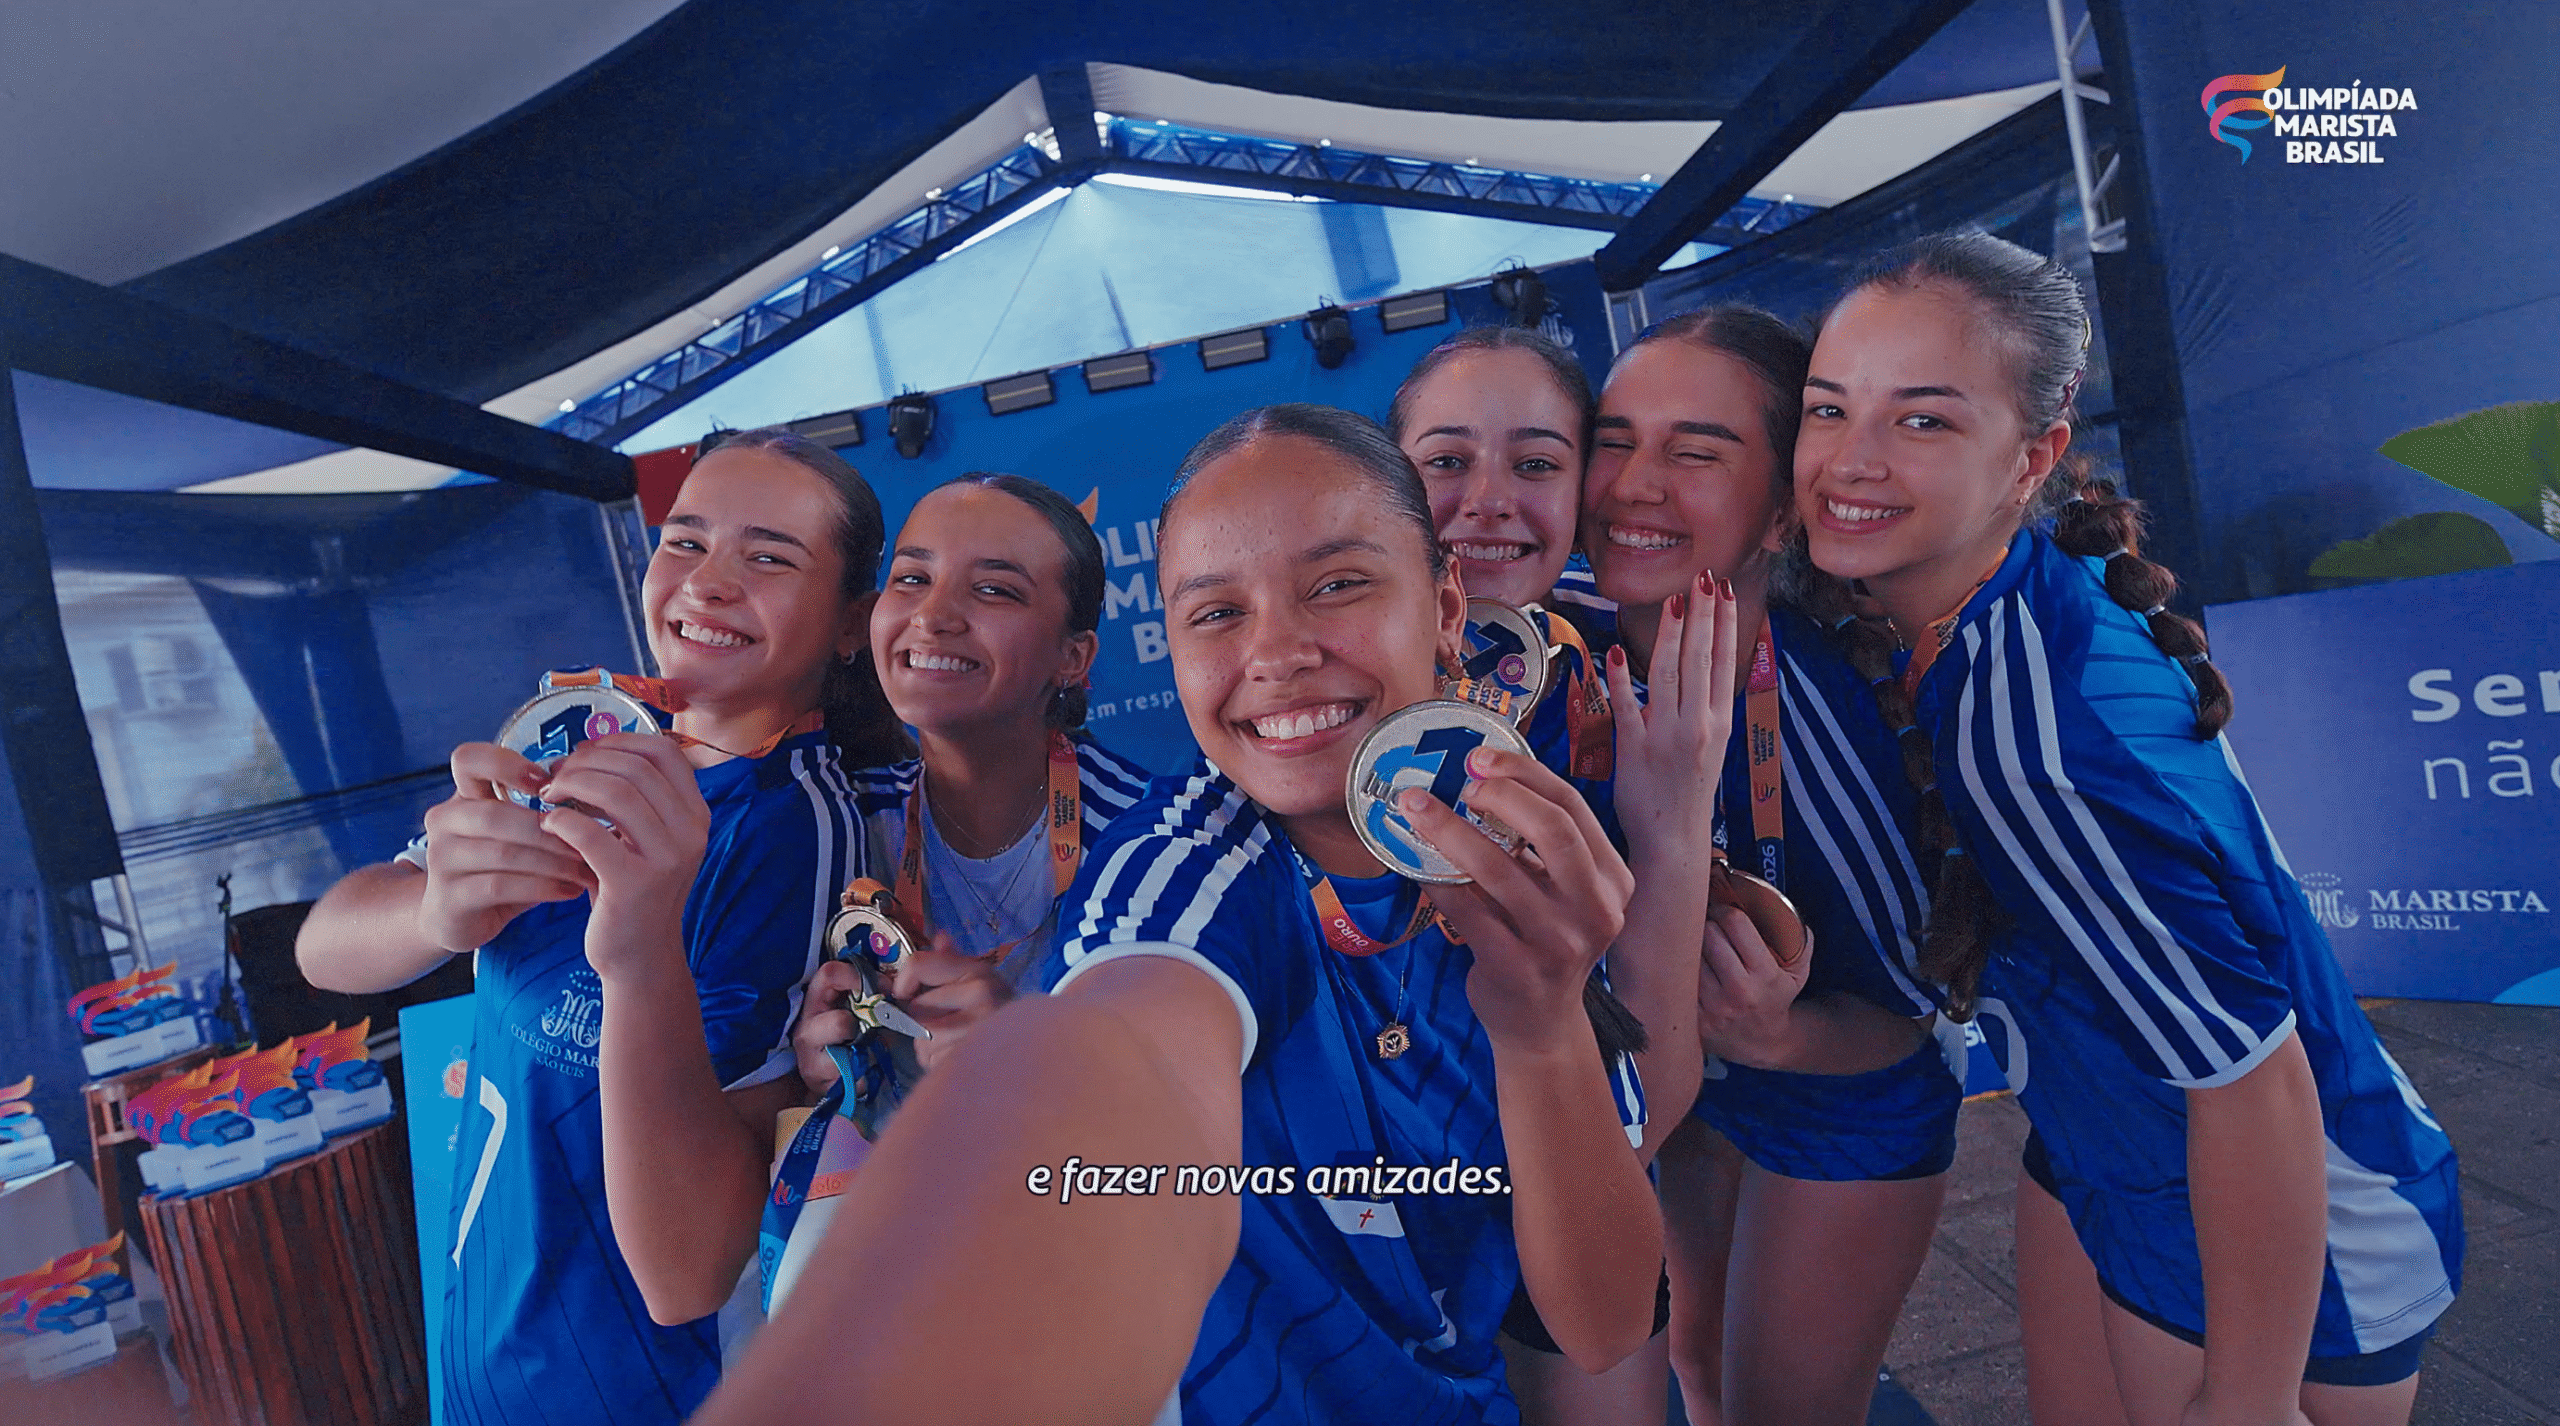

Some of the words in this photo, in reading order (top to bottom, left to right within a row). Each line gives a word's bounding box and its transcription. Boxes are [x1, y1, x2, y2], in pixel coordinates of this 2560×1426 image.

[1762, 844, 1778, 887] 026
[2368, 889, 2550, 913] MARISTA
[1334, 918, 1369, 947] OURO
[2371, 914, 2461, 931] BRASIL
[511, 1023, 561, 1057] COLÉGIO
